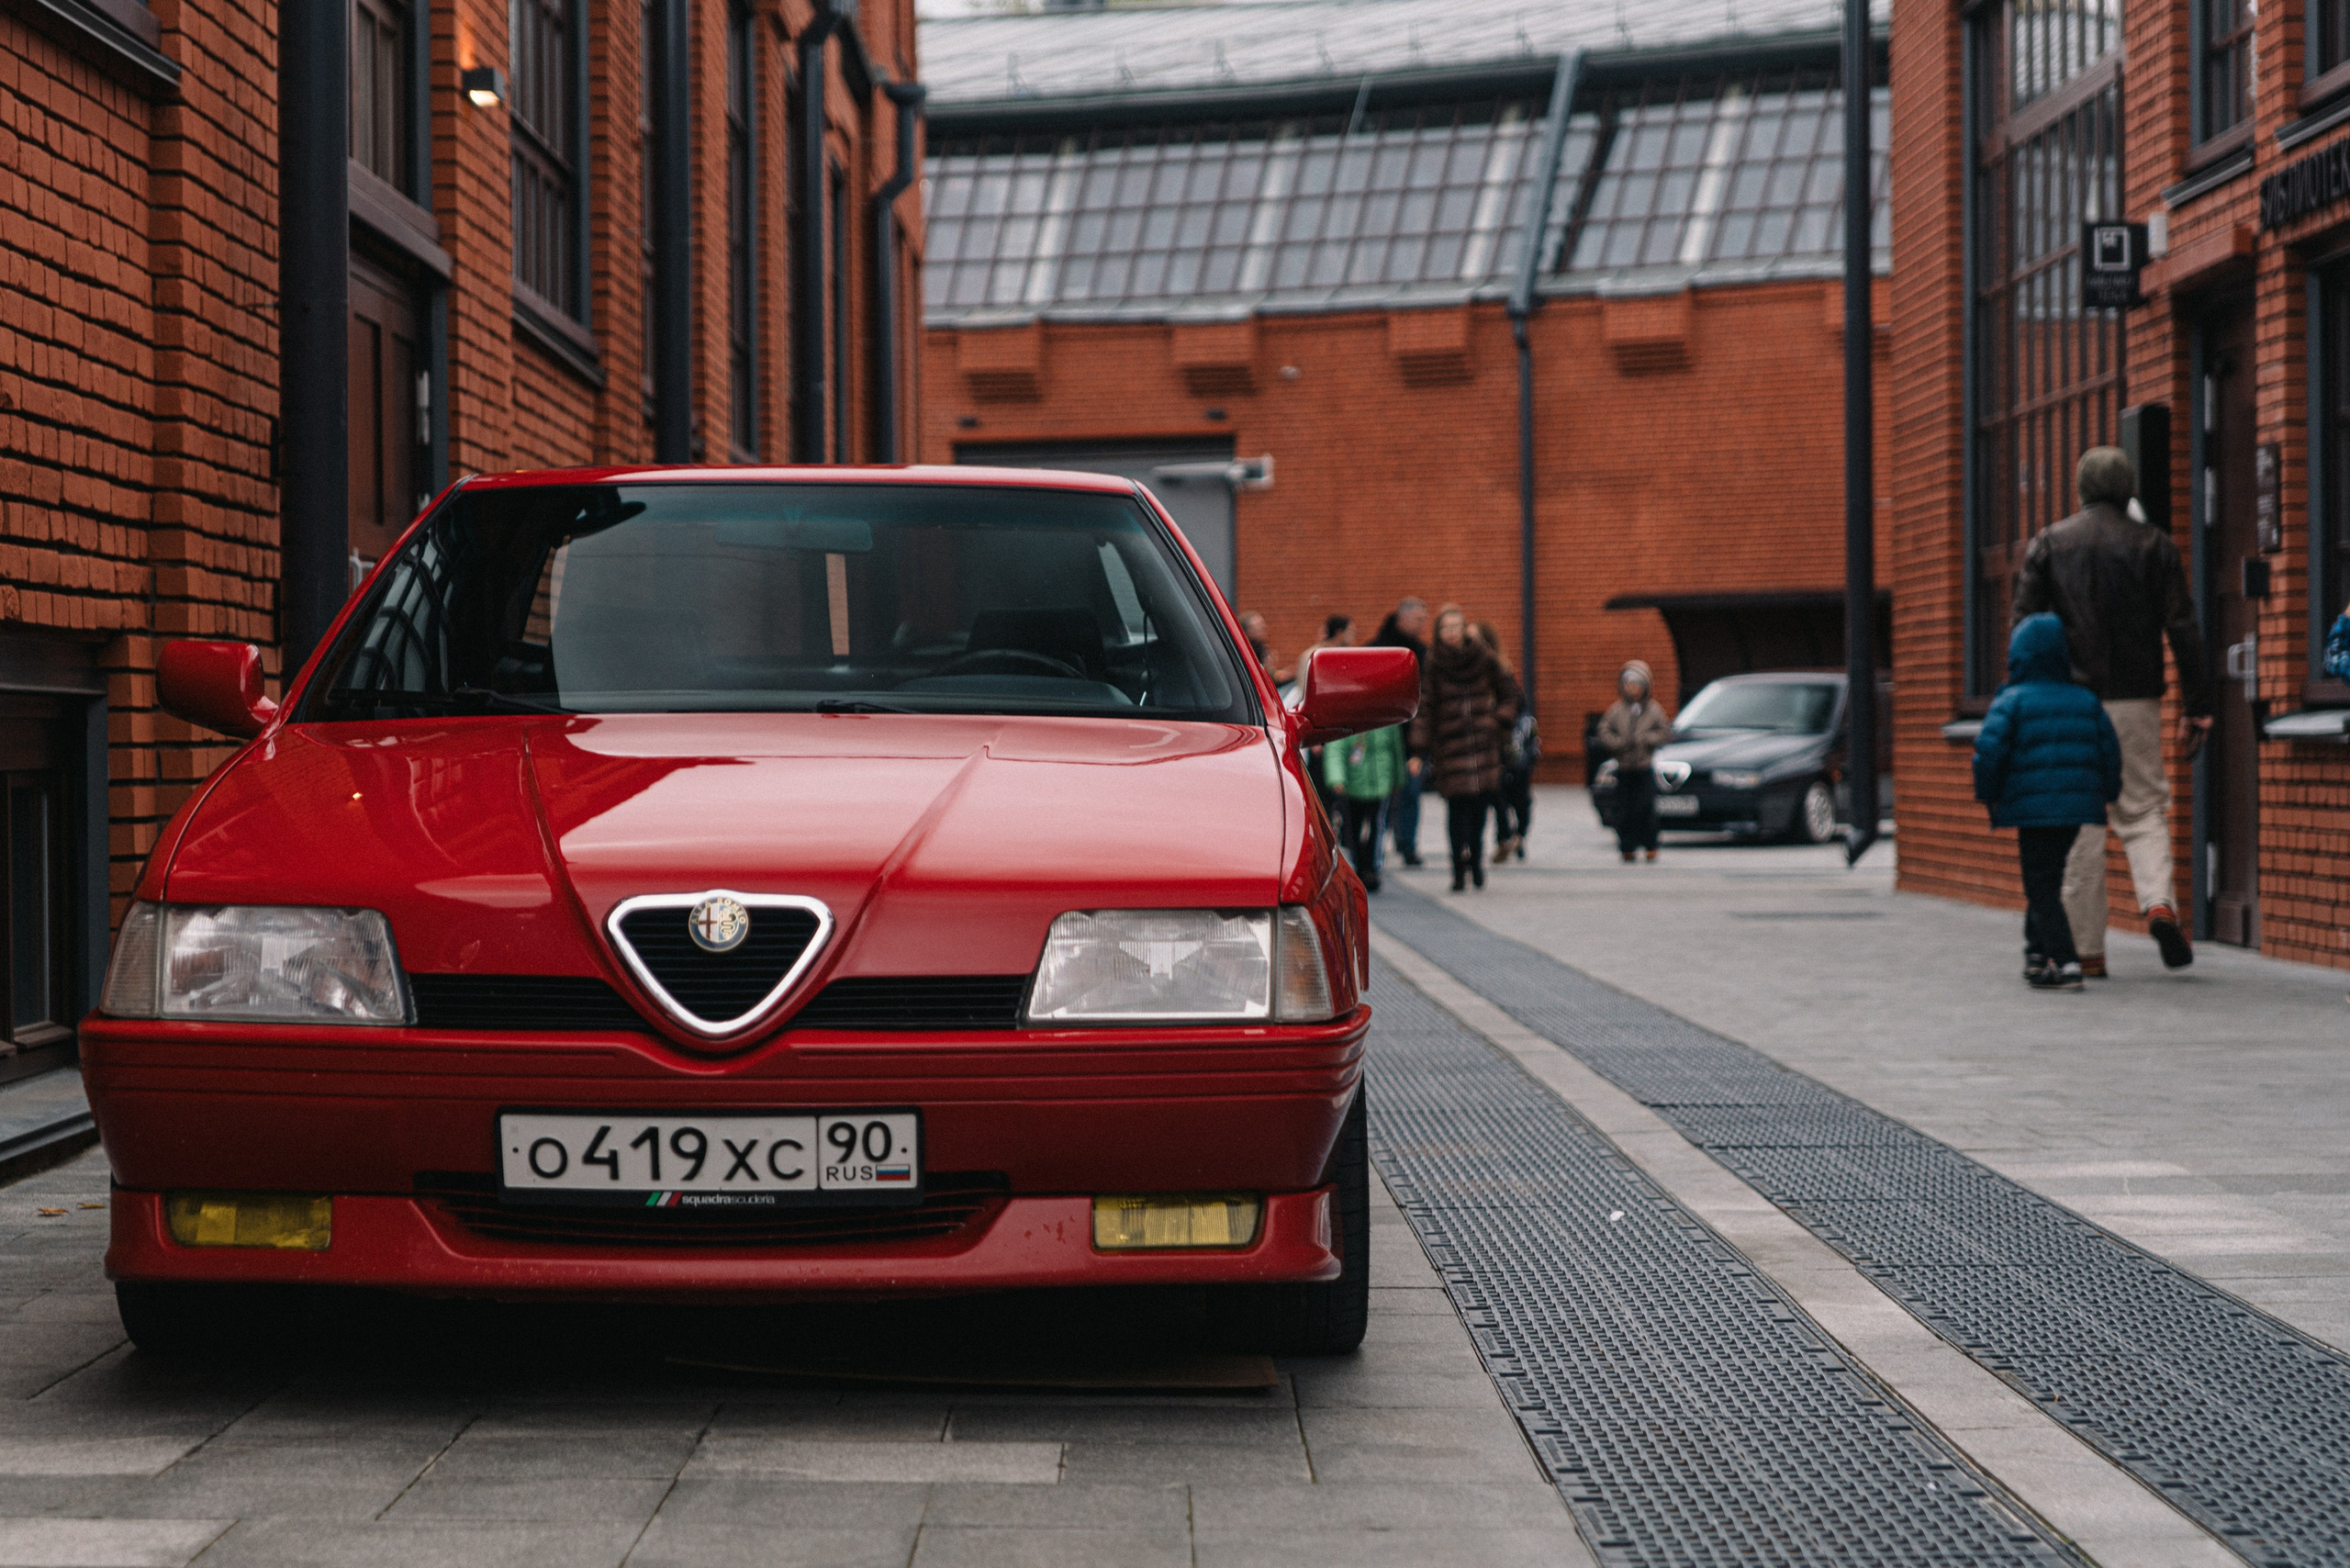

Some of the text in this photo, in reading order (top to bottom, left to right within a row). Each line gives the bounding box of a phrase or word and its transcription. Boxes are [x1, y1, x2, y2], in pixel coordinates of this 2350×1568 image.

[691, 897, 745, 924] ALFA ROMEO
[826, 1120, 893, 1164] 90
[826, 1165, 874, 1182] RUS
[681, 1193, 776, 1207] squadrascuderia
